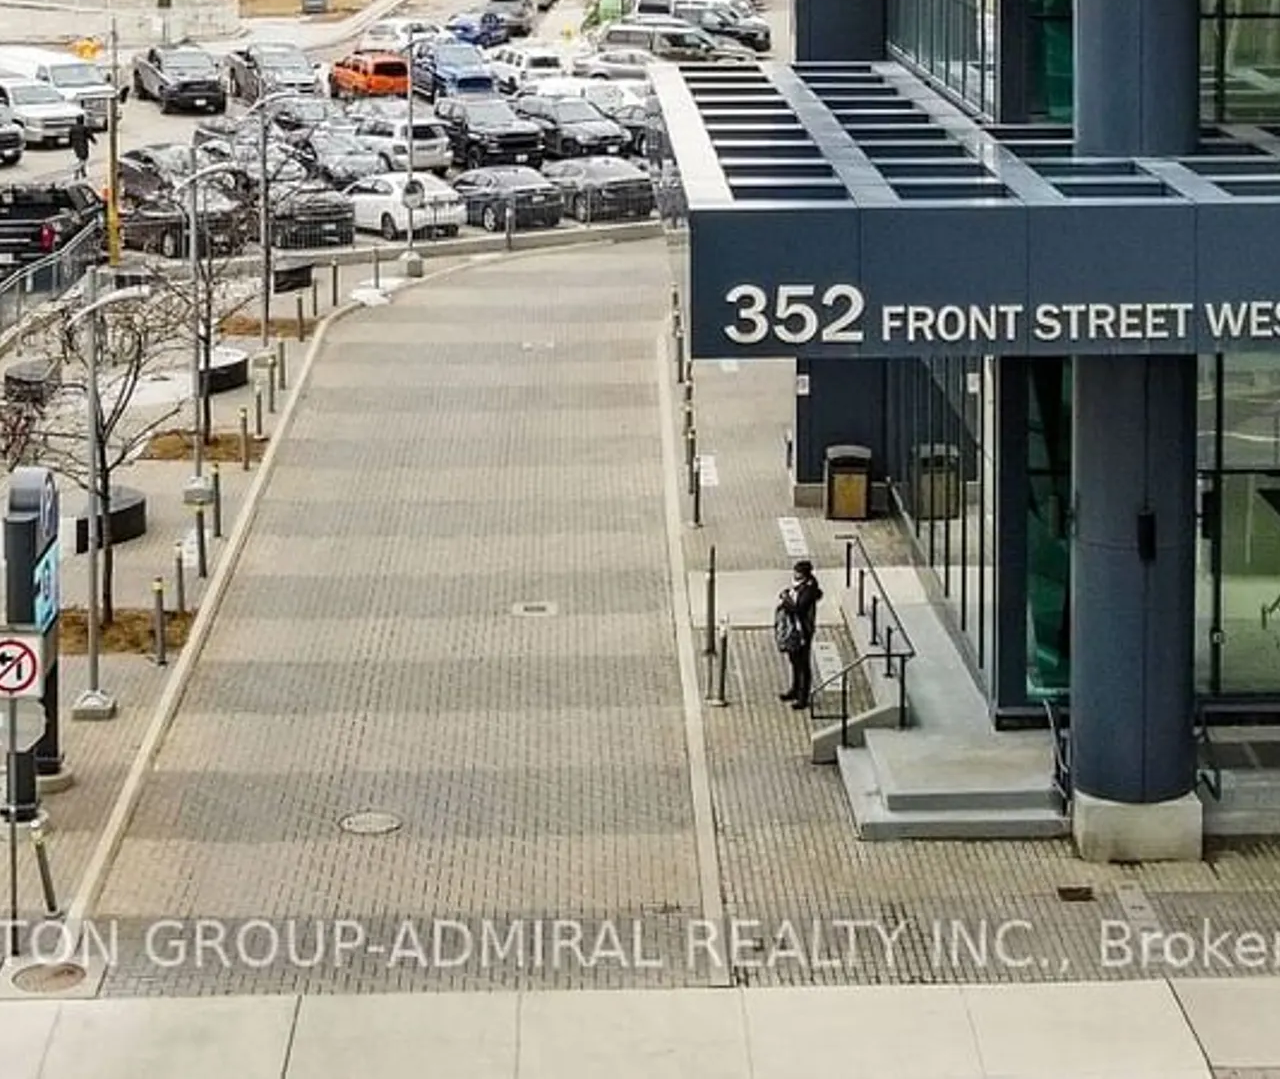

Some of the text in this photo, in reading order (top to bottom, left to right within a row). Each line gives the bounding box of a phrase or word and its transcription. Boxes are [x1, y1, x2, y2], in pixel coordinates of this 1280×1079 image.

[723, 283, 866, 345] 352
[881, 304, 1023, 342] FRONT
[1034, 302, 1194, 341] STREET
